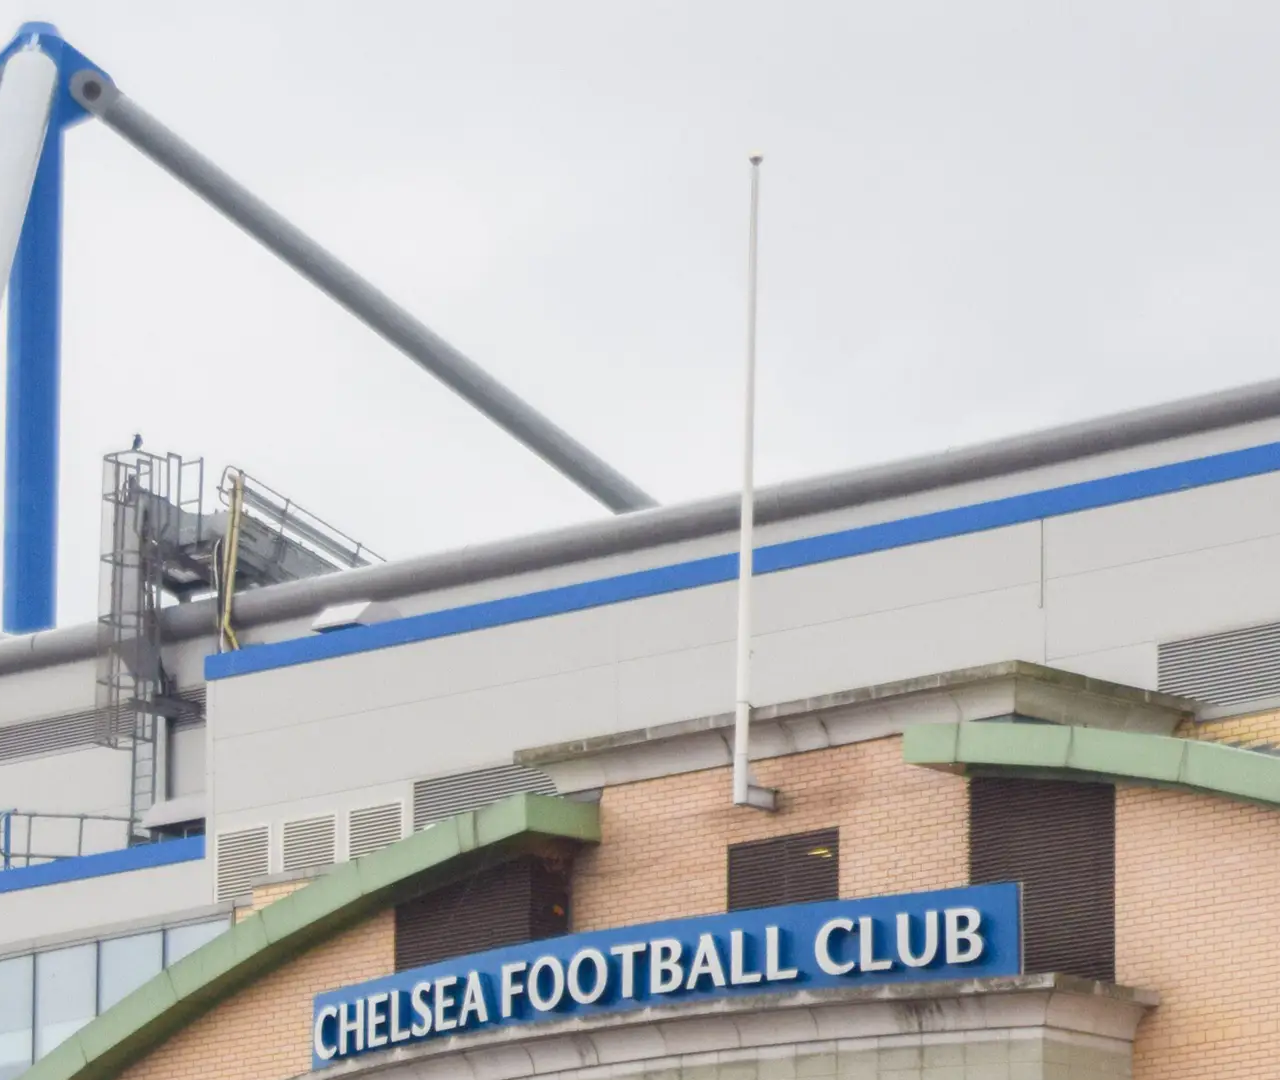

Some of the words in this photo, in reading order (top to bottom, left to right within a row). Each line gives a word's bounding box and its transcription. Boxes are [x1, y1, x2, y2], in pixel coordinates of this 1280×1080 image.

[313, 970, 489, 1061] CHELSEA
[500, 924, 799, 1018] FOOTBALL
[814, 907, 985, 976] CLUB
